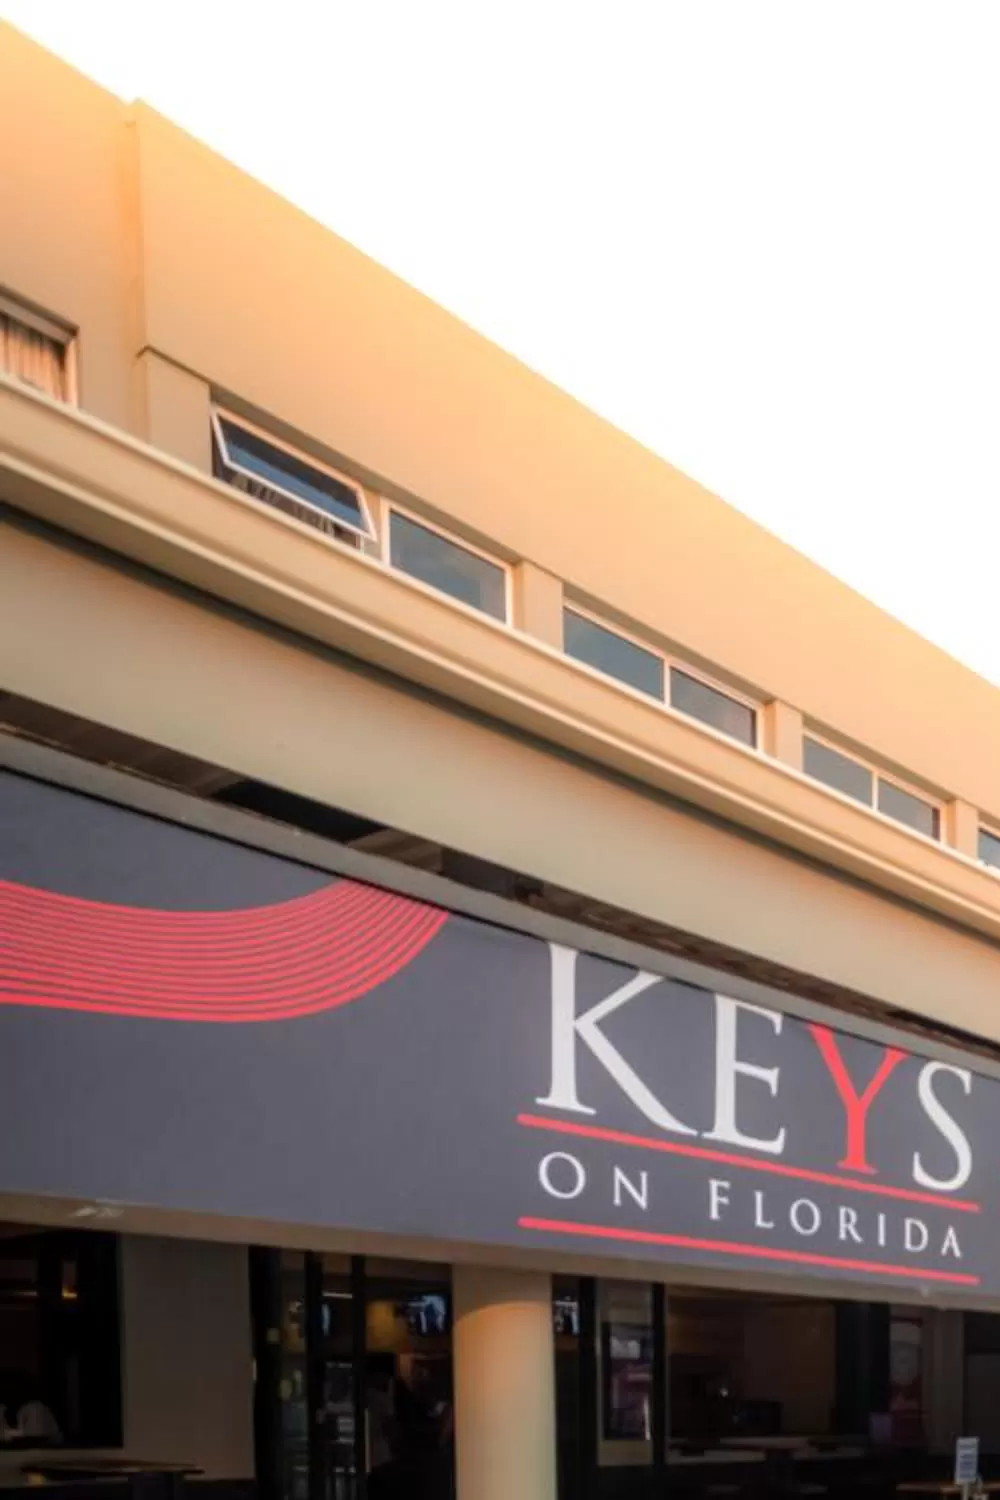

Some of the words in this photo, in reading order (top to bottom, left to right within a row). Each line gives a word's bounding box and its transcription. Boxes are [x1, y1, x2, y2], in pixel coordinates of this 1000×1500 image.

[534, 943, 973, 1192] KEYS
[538, 1151, 650, 1210] ON
[708, 1178, 963, 1258] FLORIDA
